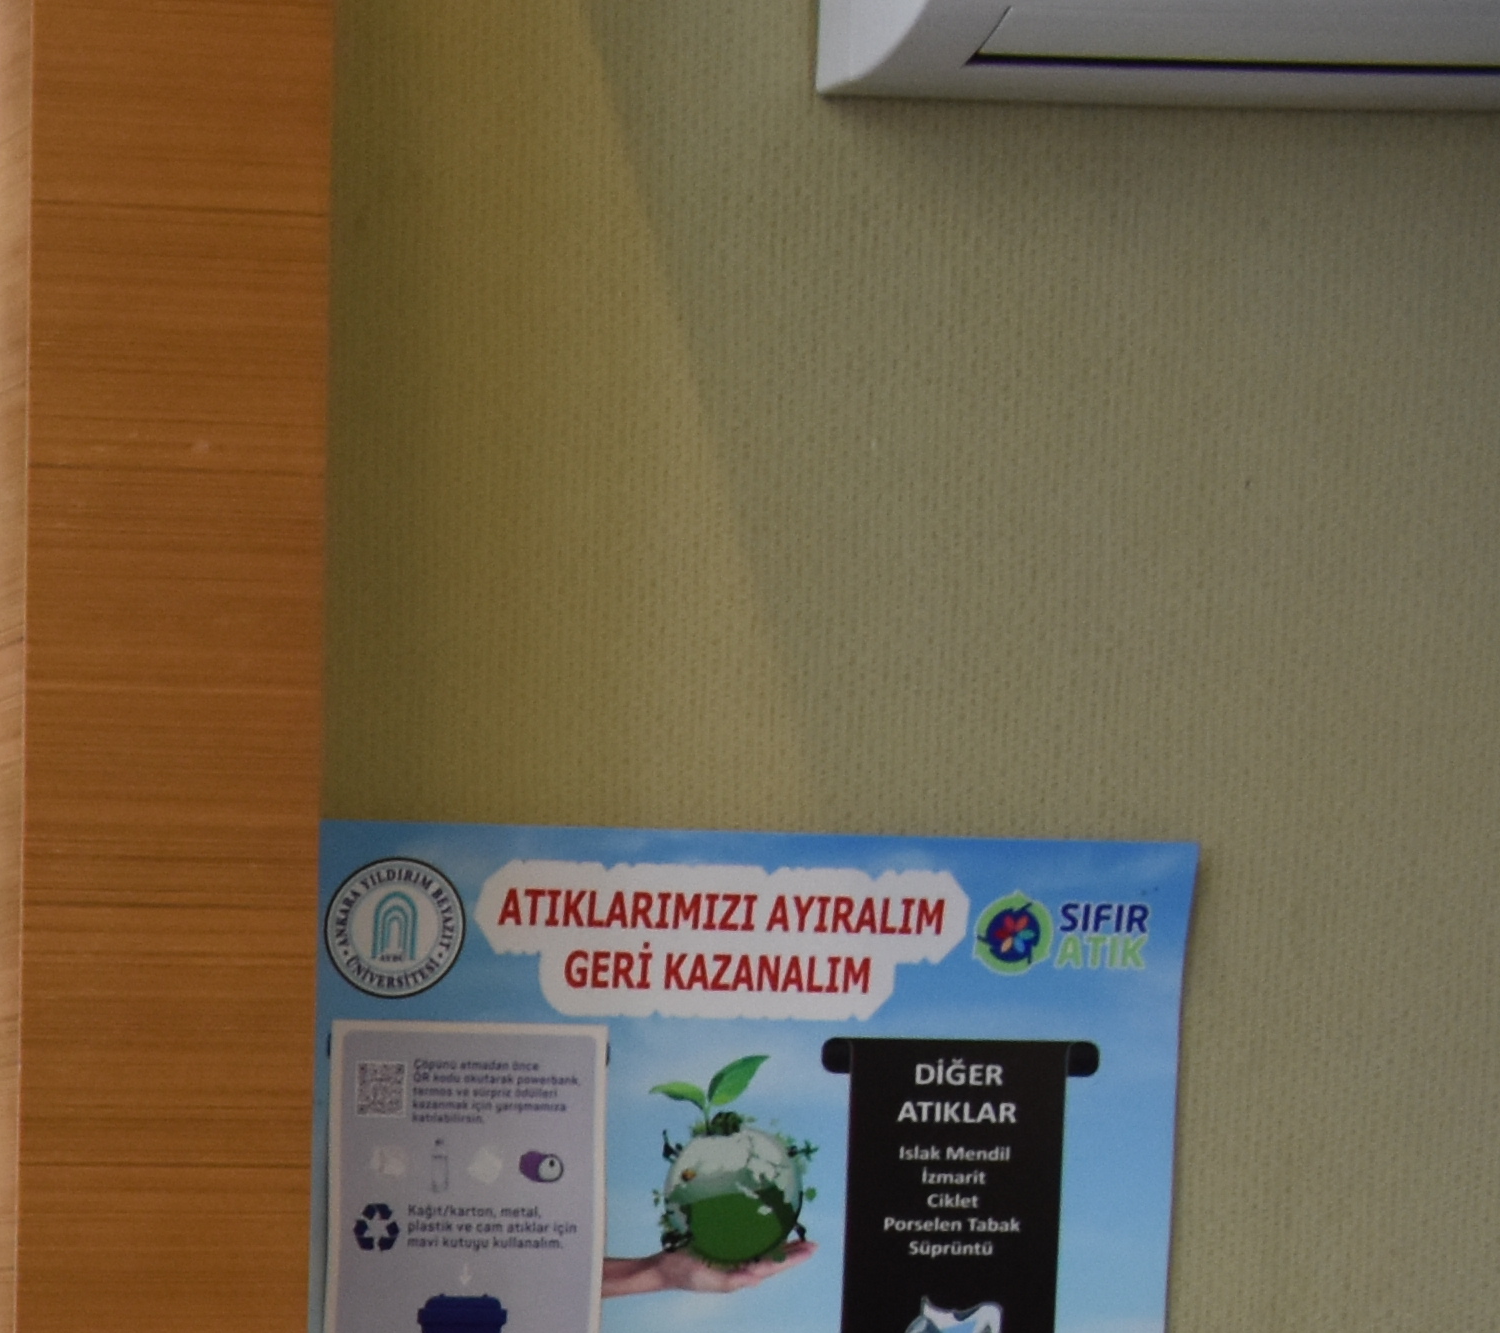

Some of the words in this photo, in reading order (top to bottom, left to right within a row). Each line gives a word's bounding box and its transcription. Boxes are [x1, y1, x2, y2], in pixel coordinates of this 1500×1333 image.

[336, 889, 360, 946] ANKARA
[360, 869, 433, 889] YILDIRIM
[431, 888, 455, 950] BEYAZIT
[498, 887, 758, 932] ATIKLARIMIZI
[765, 894, 946, 935] AYIRALIM
[1059, 902, 1150, 934] SIFIR
[1054, 934, 1148, 969] ATIK
[346, 955, 440, 988] ÜNİVERSİTESİ
[563, 941, 652, 990] GERİ
[663, 953, 871, 994] KAZANALIM
[914, 1058, 1004, 1086] DİĞER
[896, 1100, 1017, 1124] ATIKLAR
[899, 1145, 941, 1161] Islak
[946, 1145, 1011, 1162] Mendil
[921, 1166, 987, 1185] İzmarit
[926, 1193, 979, 1208] Ciklet
[407, 1221, 452, 1235] plastik
[456, 1223, 472, 1233] ve
[476, 1223, 502, 1233] cam
[506, 1221, 550, 1233] atıklar
[553, 1222, 578, 1236] için
[883, 1216, 962, 1232] Porselen
[967, 1216, 1021, 1233] Tabak
[407, 1237, 438, 1248] mavi
[442, 1237, 490, 1251] kutuyu
[492, 1236, 563, 1249] kullanalım.
[908, 1240, 994, 1258] Süprüntü
